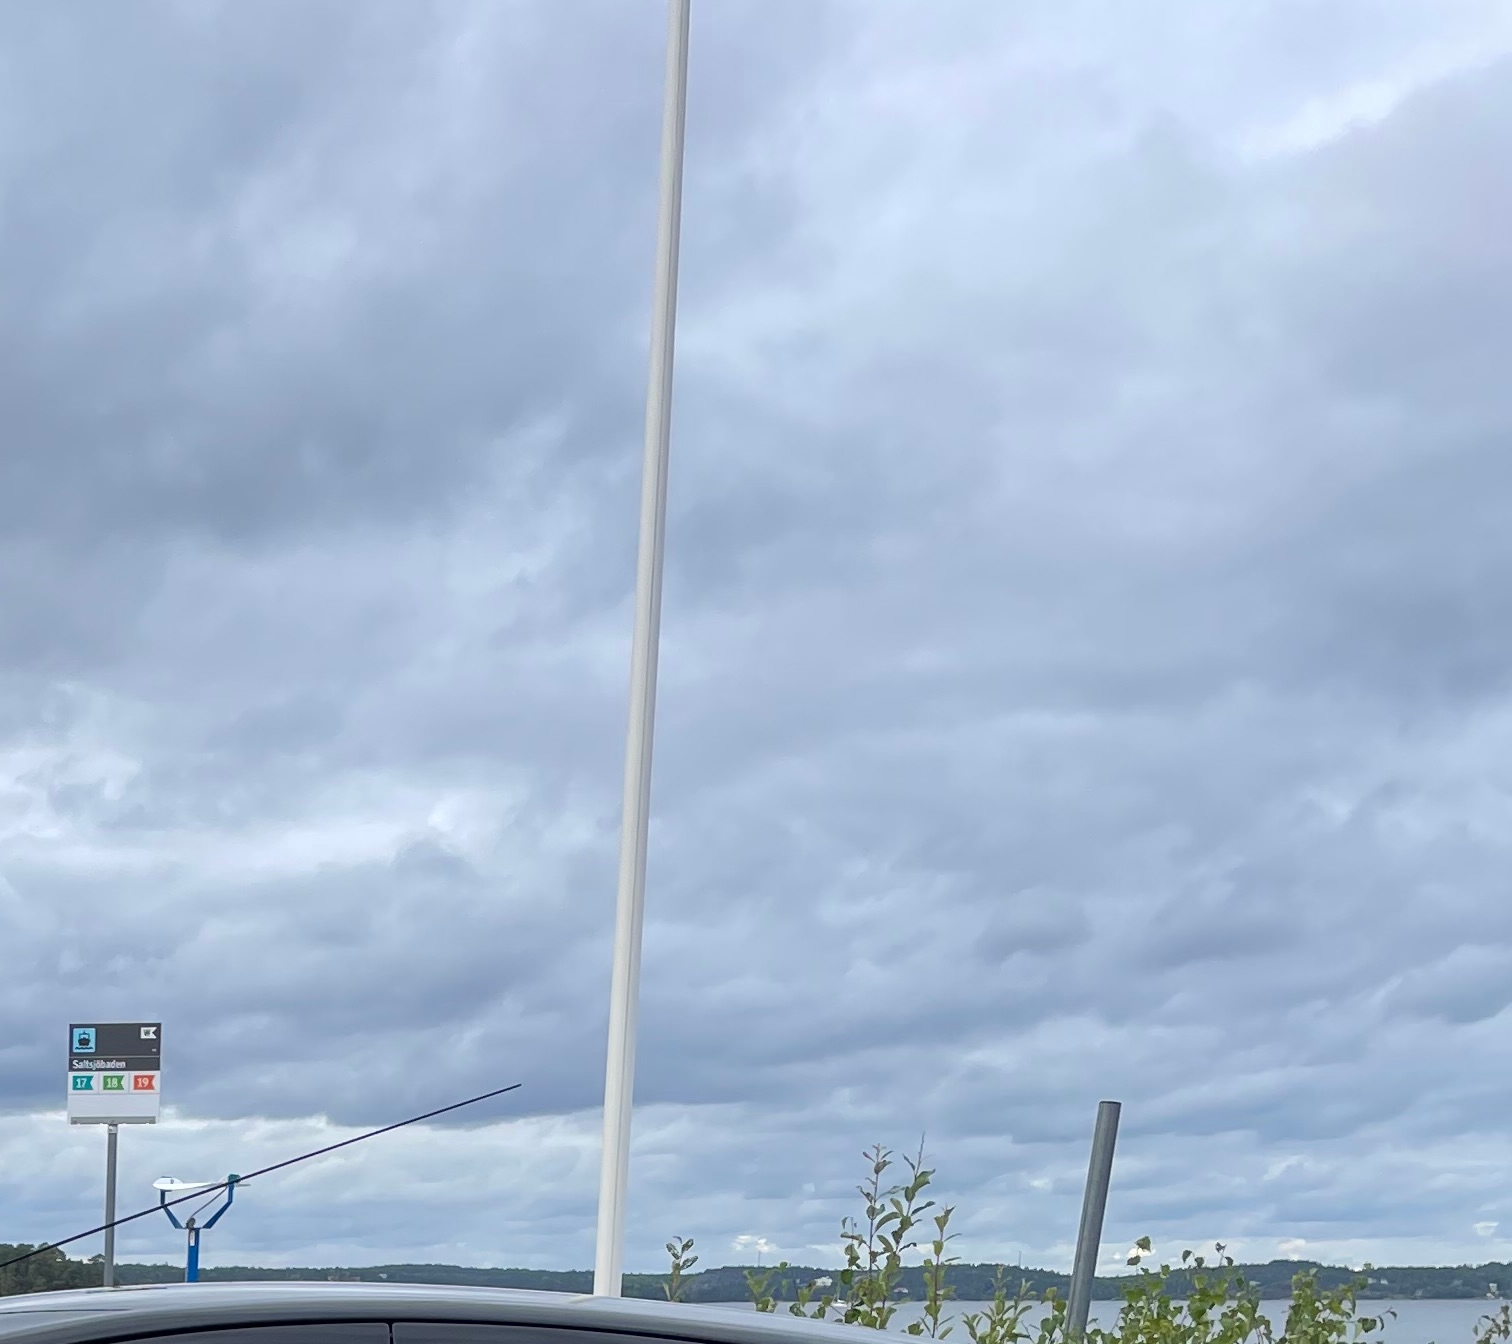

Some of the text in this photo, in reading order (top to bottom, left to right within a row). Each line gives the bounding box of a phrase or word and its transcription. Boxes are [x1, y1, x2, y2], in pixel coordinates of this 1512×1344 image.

[72, 1060, 126, 1070] Saltsjöbaden
[76, 1077, 149, 1088] 17 18 19
